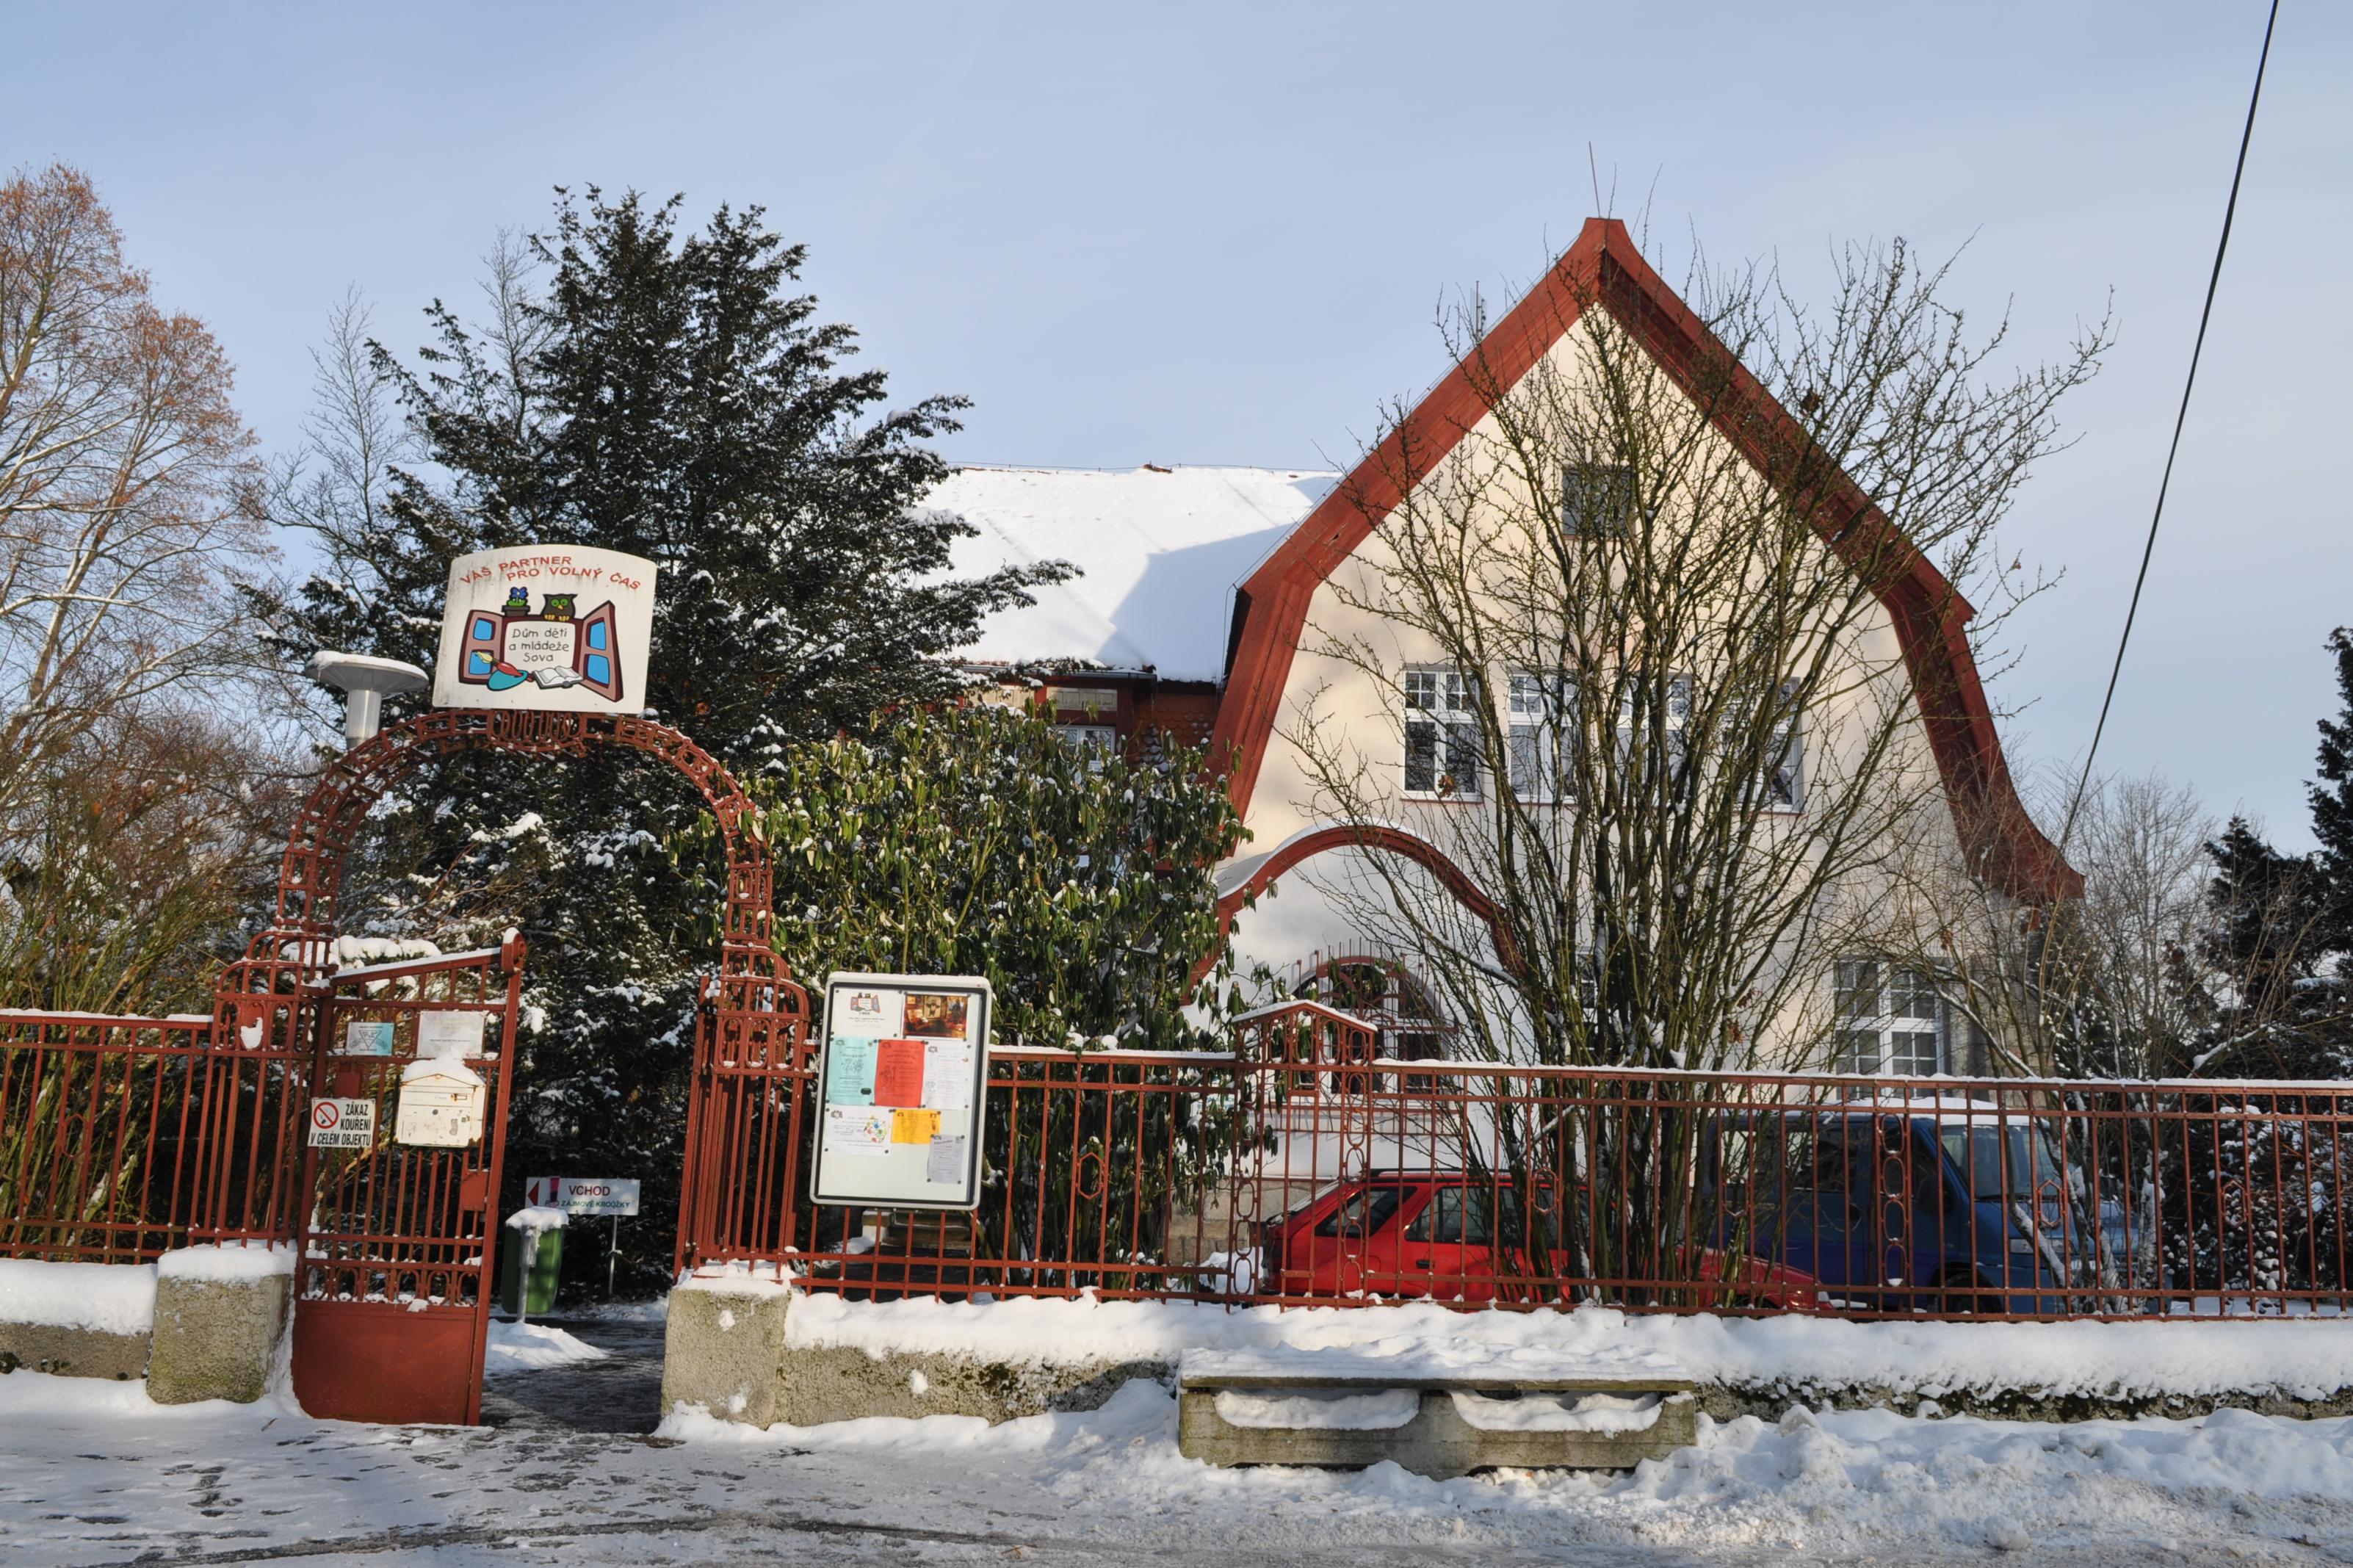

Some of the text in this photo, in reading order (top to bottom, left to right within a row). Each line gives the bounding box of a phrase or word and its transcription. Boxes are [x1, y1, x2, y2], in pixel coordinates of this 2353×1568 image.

[460, 557, 571, 583] VÁŠ PARTNER
[507, 567, 640, 589] PRO VOLNÝ ČAS
[512, 628, 538, 638] Dům
[521, 641, 569, 651] mládeže
[523, 652, 554, 662] Sova
[345, 1101, 369, 1116] ZÁKAZ
[340, 1116, 372, 1131] KOUŘENÍ
[311, 1131, 371, 1146] V CELÉM OBJEKTU
[568, 1185, 611, 1196] VCHOD
[561, 1199, 594, 1207] ZÁJMOVÉ
